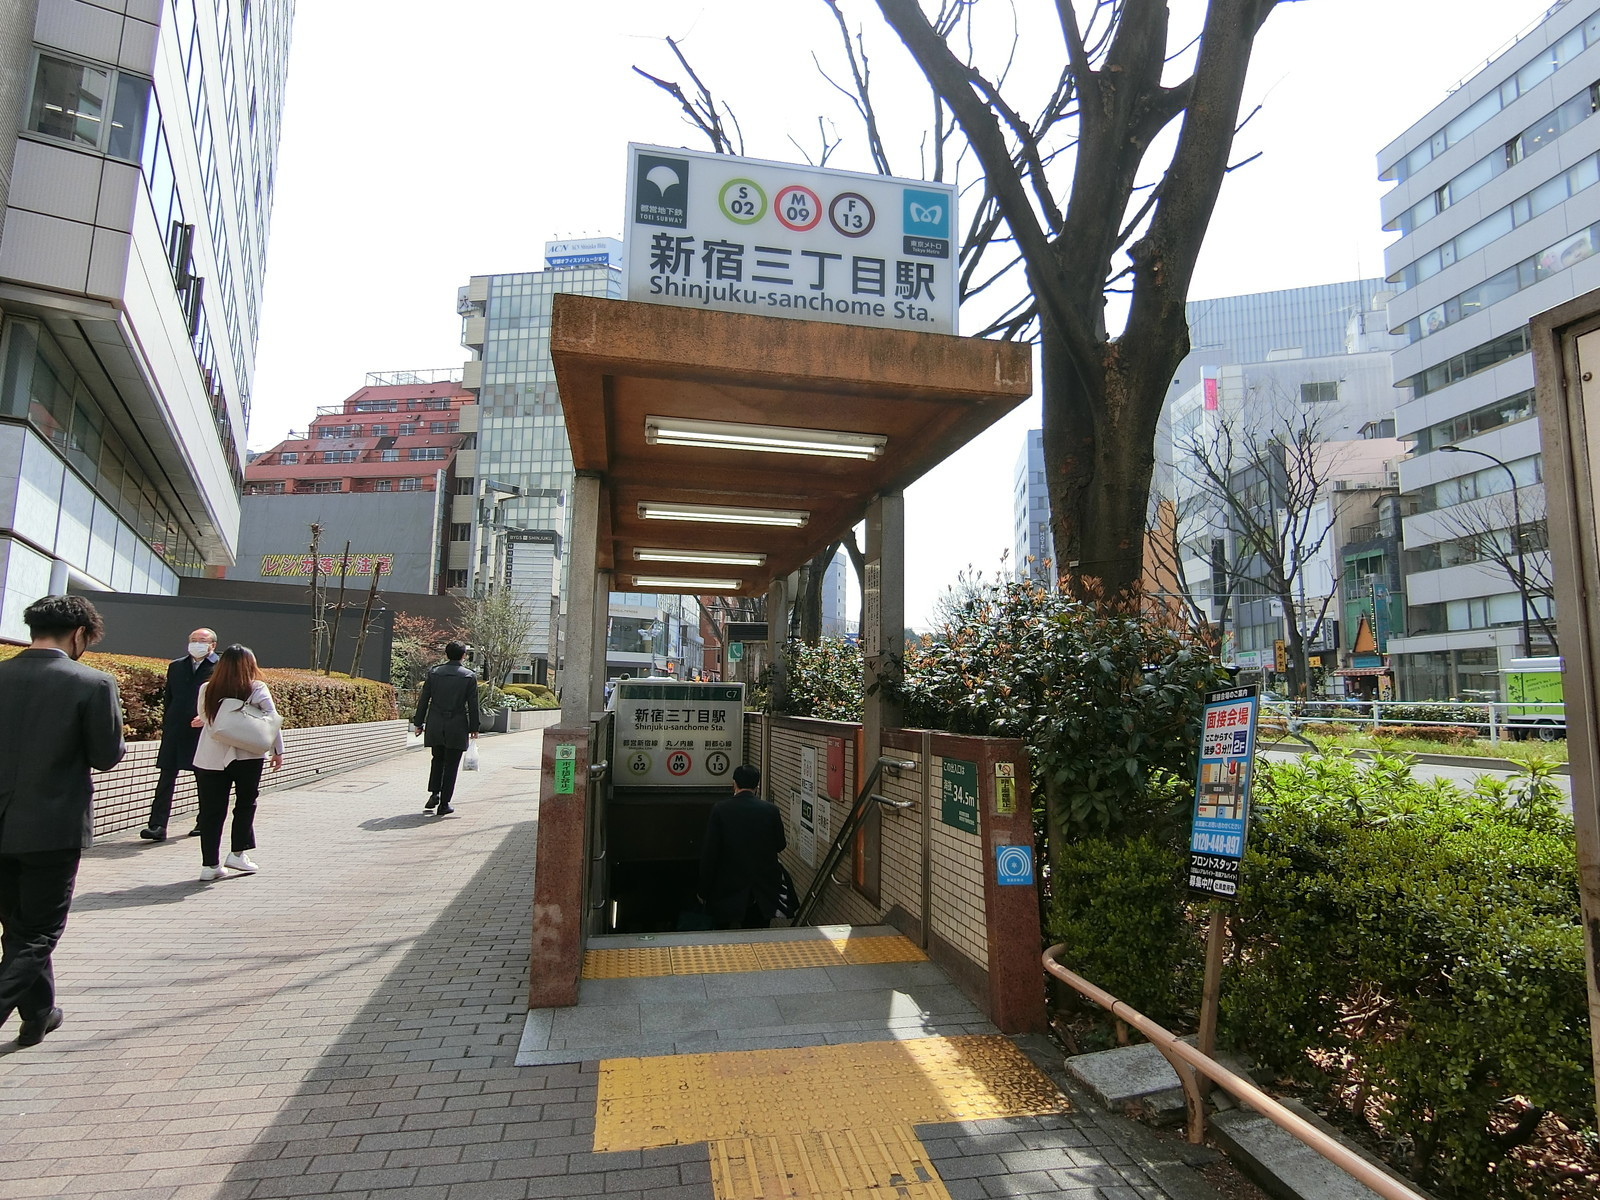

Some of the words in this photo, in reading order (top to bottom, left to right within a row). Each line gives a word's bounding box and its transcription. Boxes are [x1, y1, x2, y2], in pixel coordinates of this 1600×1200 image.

[739, 186, 748, 199] S
[790, 192, 806, 207] M
[847, 200, 857, 212] F
[640, 204, 683, 216] 都営地下鉄
[731, 199, 755, 217] 02
[786, 206, 810, 222] 09
[656, 215, 683, 224] SUBWAY
[842, 213, 863, 229] 13
[911, 240, 942, 250] 東京メトロ
[650, 232, 936, 302] 新宿三丁目駅
[650, 275, 886, 318] Shinjuku-sanchome
[893, 301, 935, 323] Sta.
[265, 556, 392, 574] レンガ落下注意
[725, 690, 738, 698] C7
[634, 708, 726, 723] 新宿三丁目駅
[1206, 707, 1249, 729] 面接会場
[634, 722, 709, 732] Shinjuku-sanchome
[711, 723, 725, 731] Sta.
[1205, 732, 1233, 742] ここからすぐ
[704, 740, 732, 748] 副都心線
[1233, 740, 1246, 754] 2F
[633, 762, 646, 771] 02
[673, 762, 685, 771] 09
[712, 762, 724, 771] 13
[953, 785, 975, 807] 34.5m
[1191, 855, 1238, 871] フロントスタッフ
